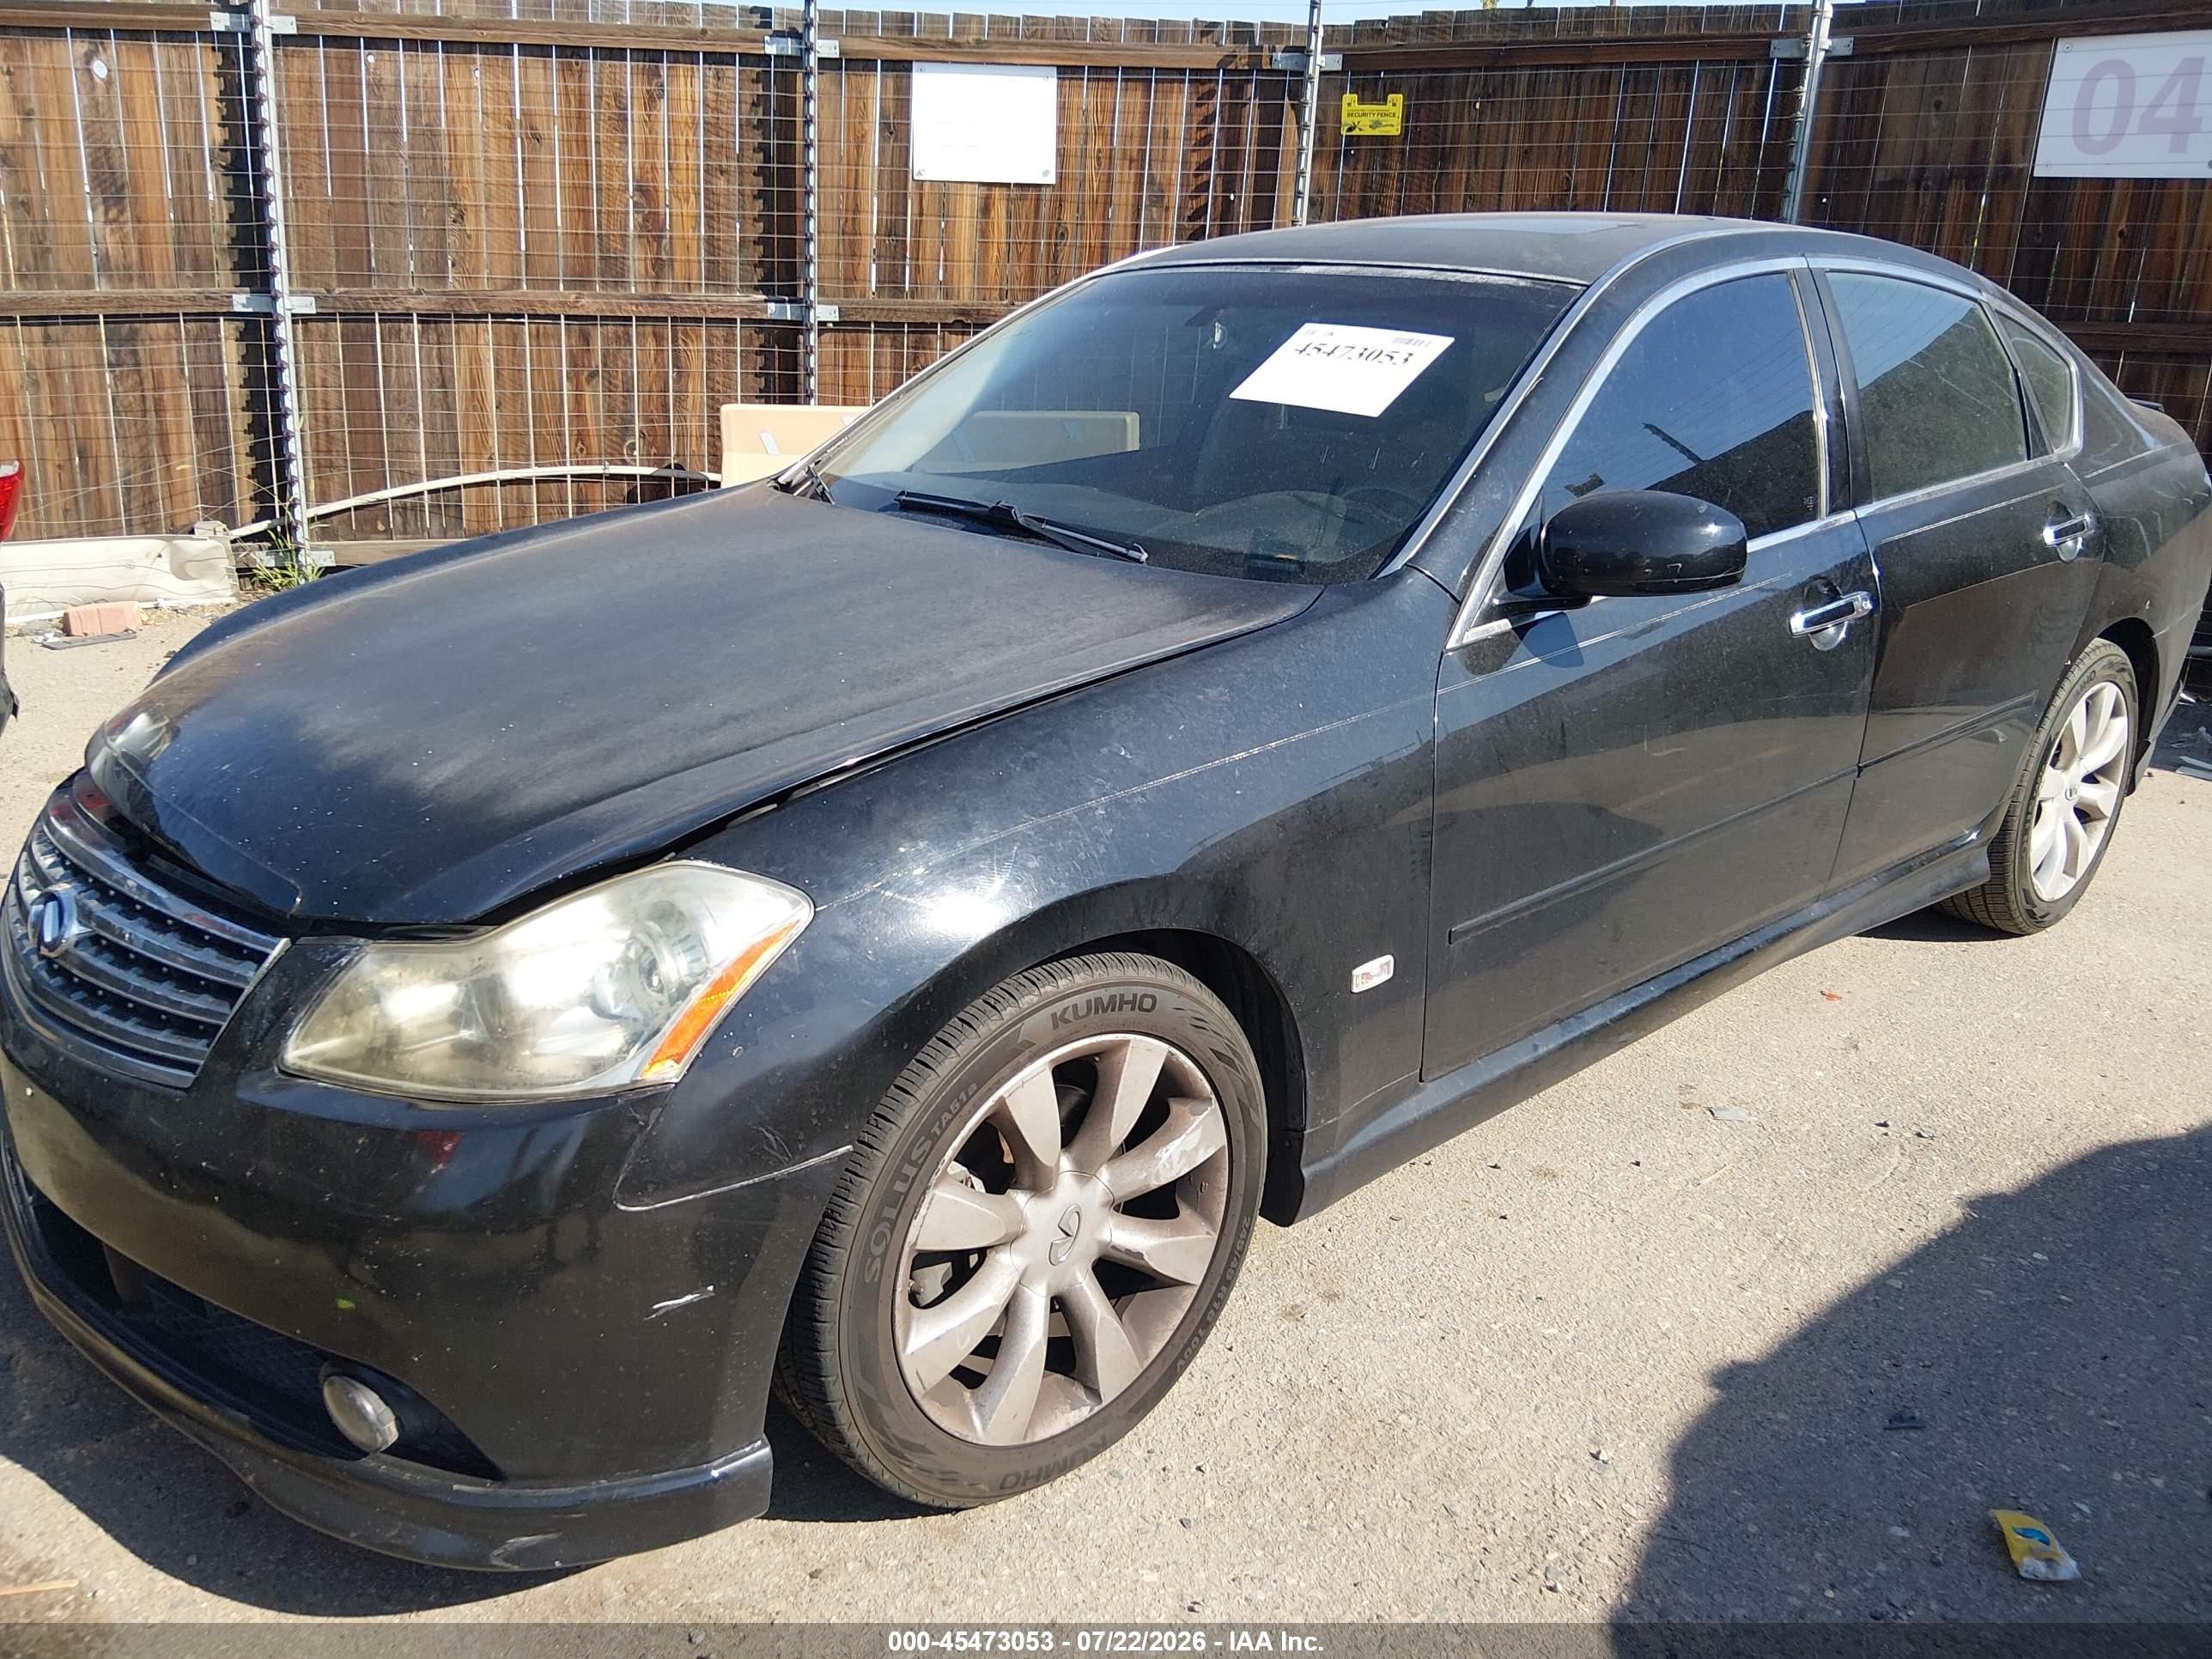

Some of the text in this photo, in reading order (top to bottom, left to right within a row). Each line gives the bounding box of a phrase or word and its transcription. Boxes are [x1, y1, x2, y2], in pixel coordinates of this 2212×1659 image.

[2072, 55, 2205, 155] 04
[1294, 342, 1416, 366] 45473053
[1050, 993, 1158, 1030] KUMHO
[864, 1135, 933, 1284] SOLUS
